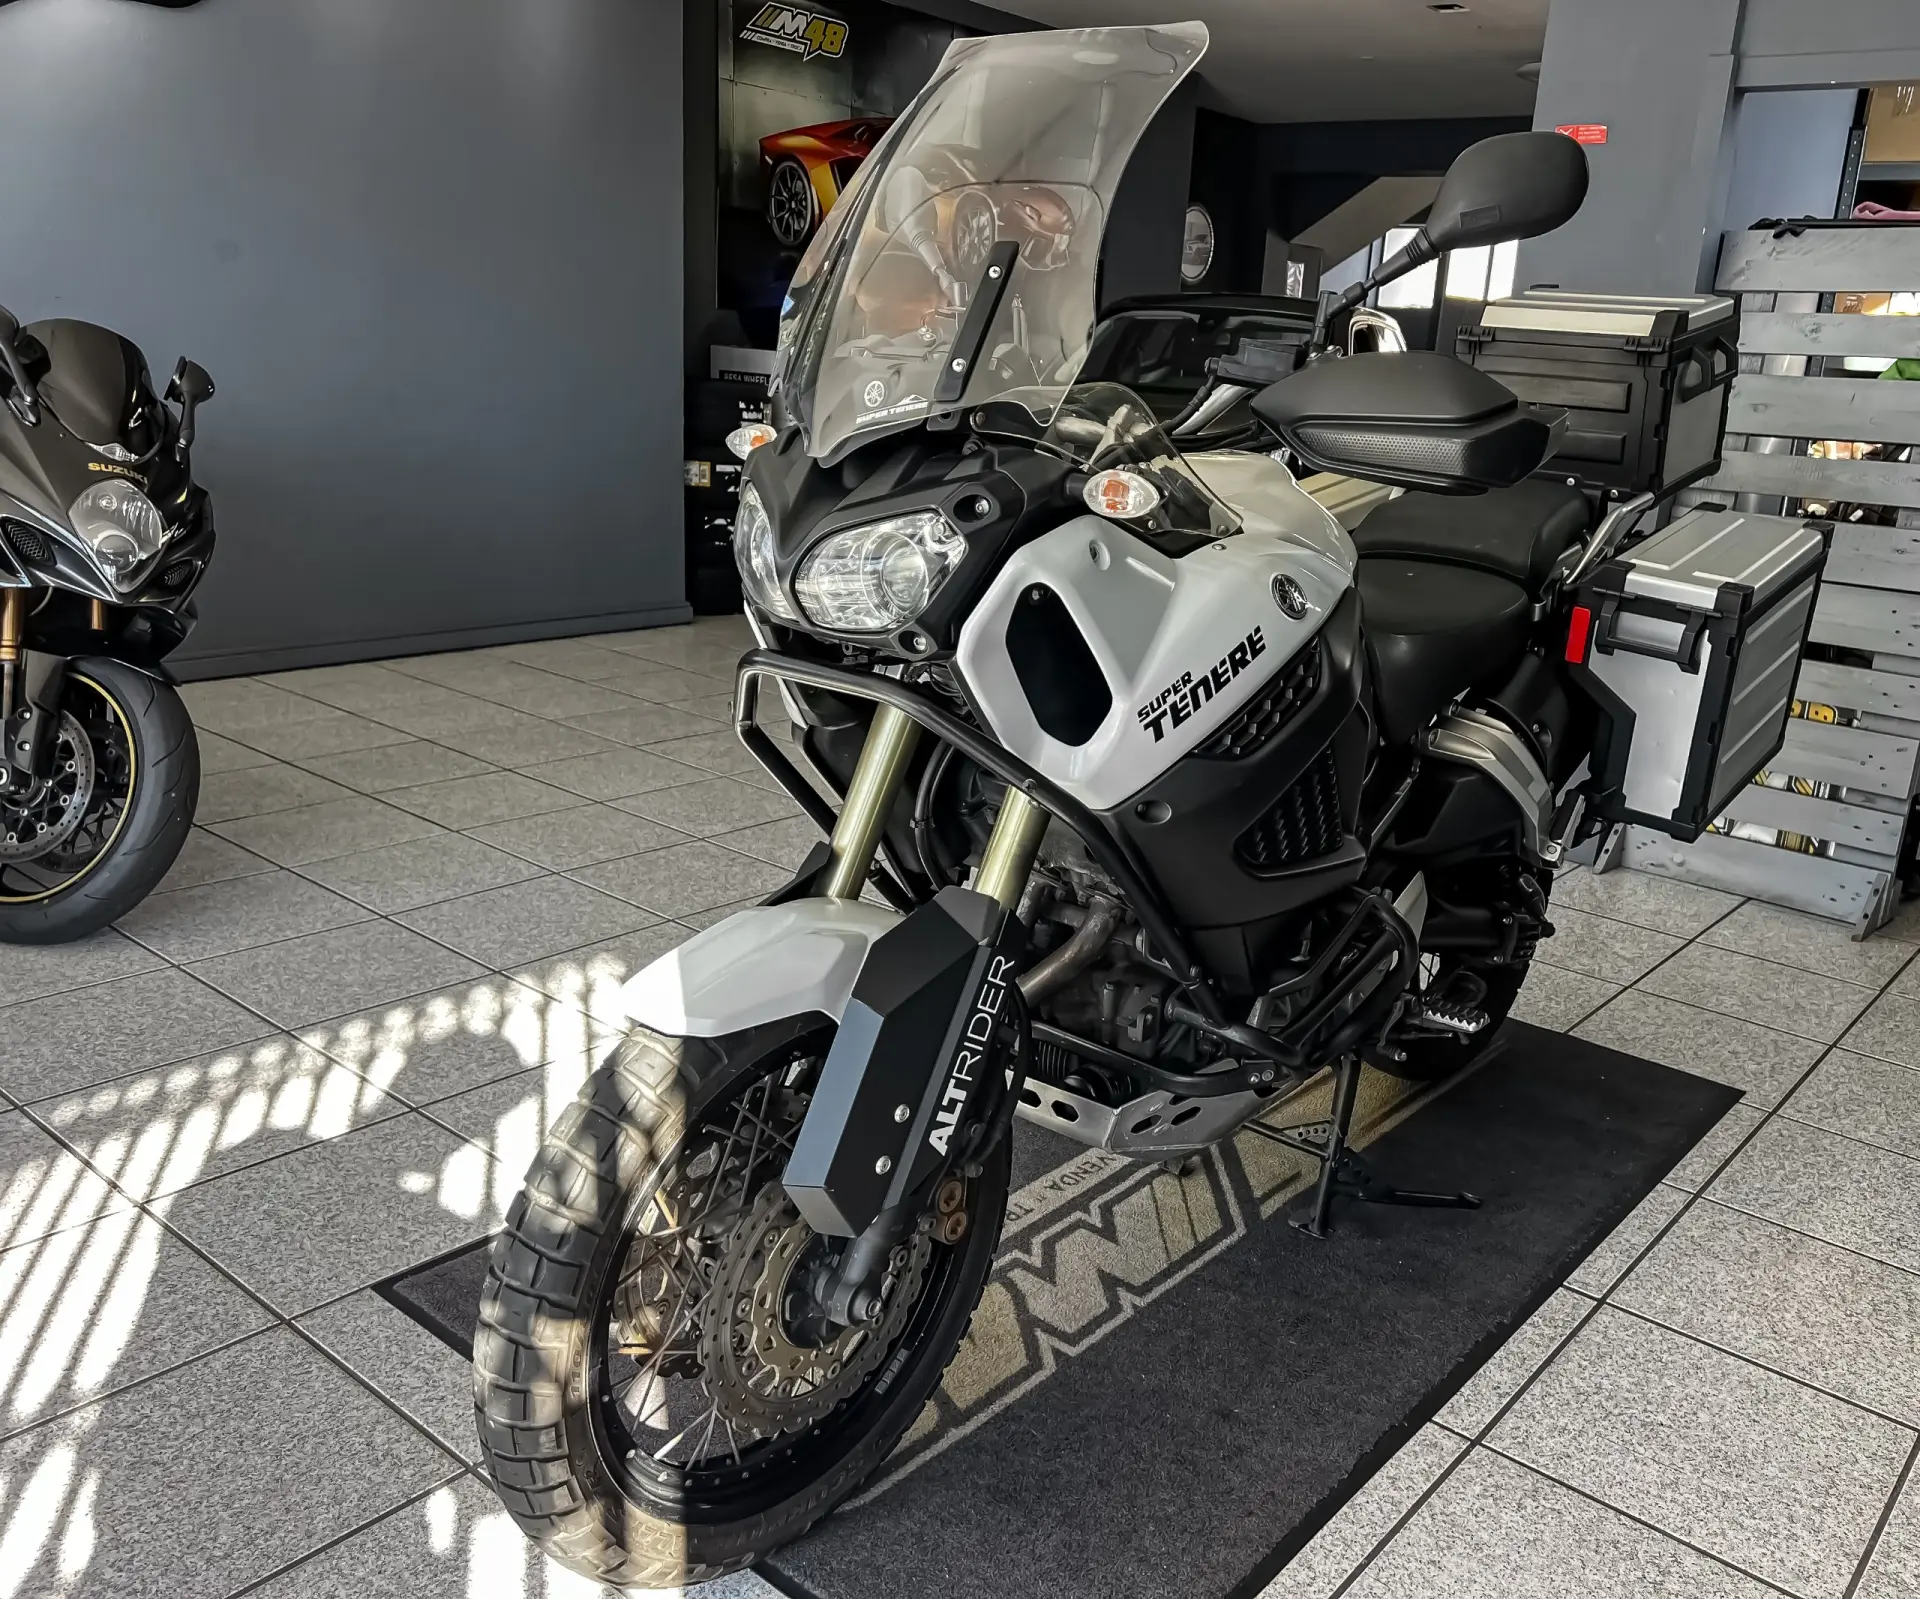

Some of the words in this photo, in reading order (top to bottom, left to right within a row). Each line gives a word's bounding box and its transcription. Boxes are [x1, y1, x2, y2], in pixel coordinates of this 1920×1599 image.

[743, 375, 771, 386] WHEEL
[88, 462, 148, 484] SUZUKI
[1137, 670, 1194, 724] SUPER
[928, 955, 1015, 1157] ALTRIDER
[1043, 1155, 1117, 1192] VENDA
